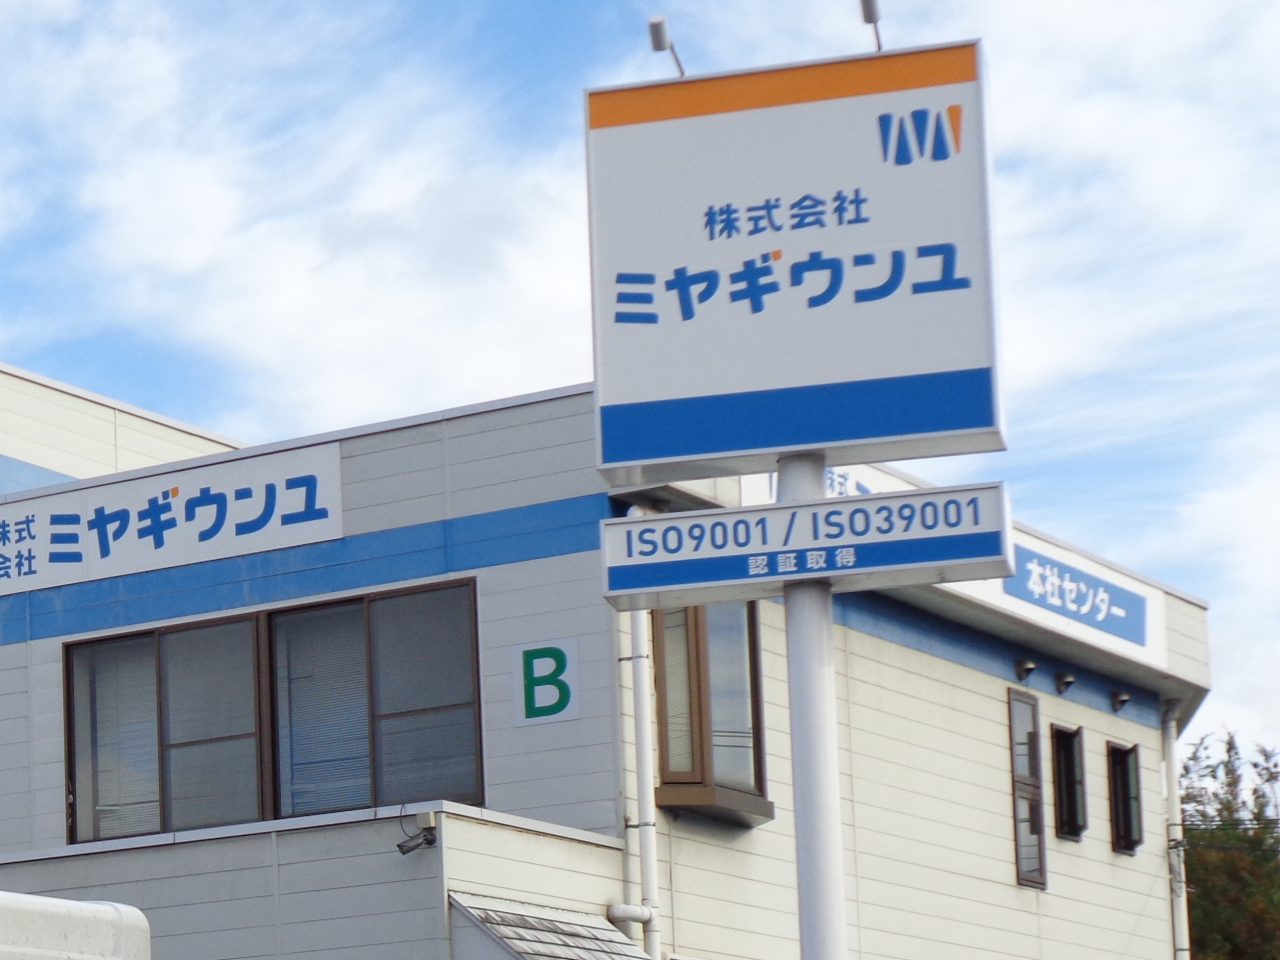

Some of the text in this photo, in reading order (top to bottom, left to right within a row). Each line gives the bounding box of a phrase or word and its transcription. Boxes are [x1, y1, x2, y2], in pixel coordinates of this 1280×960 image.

[704, 188, 870, 241] 株式会社
[614, 242, 971, 325] ミヤギウンユ
[48, 474, 329, 564] ミヤギウンユ
[626, 516, 769, 559] ISO9001
[811, 497, 981, 541] ISO39001
[748, 548, 857, 575] 認証取得
[1026, 558, 1126, 622] 本社センター
[522, 646, 571, 719] B
